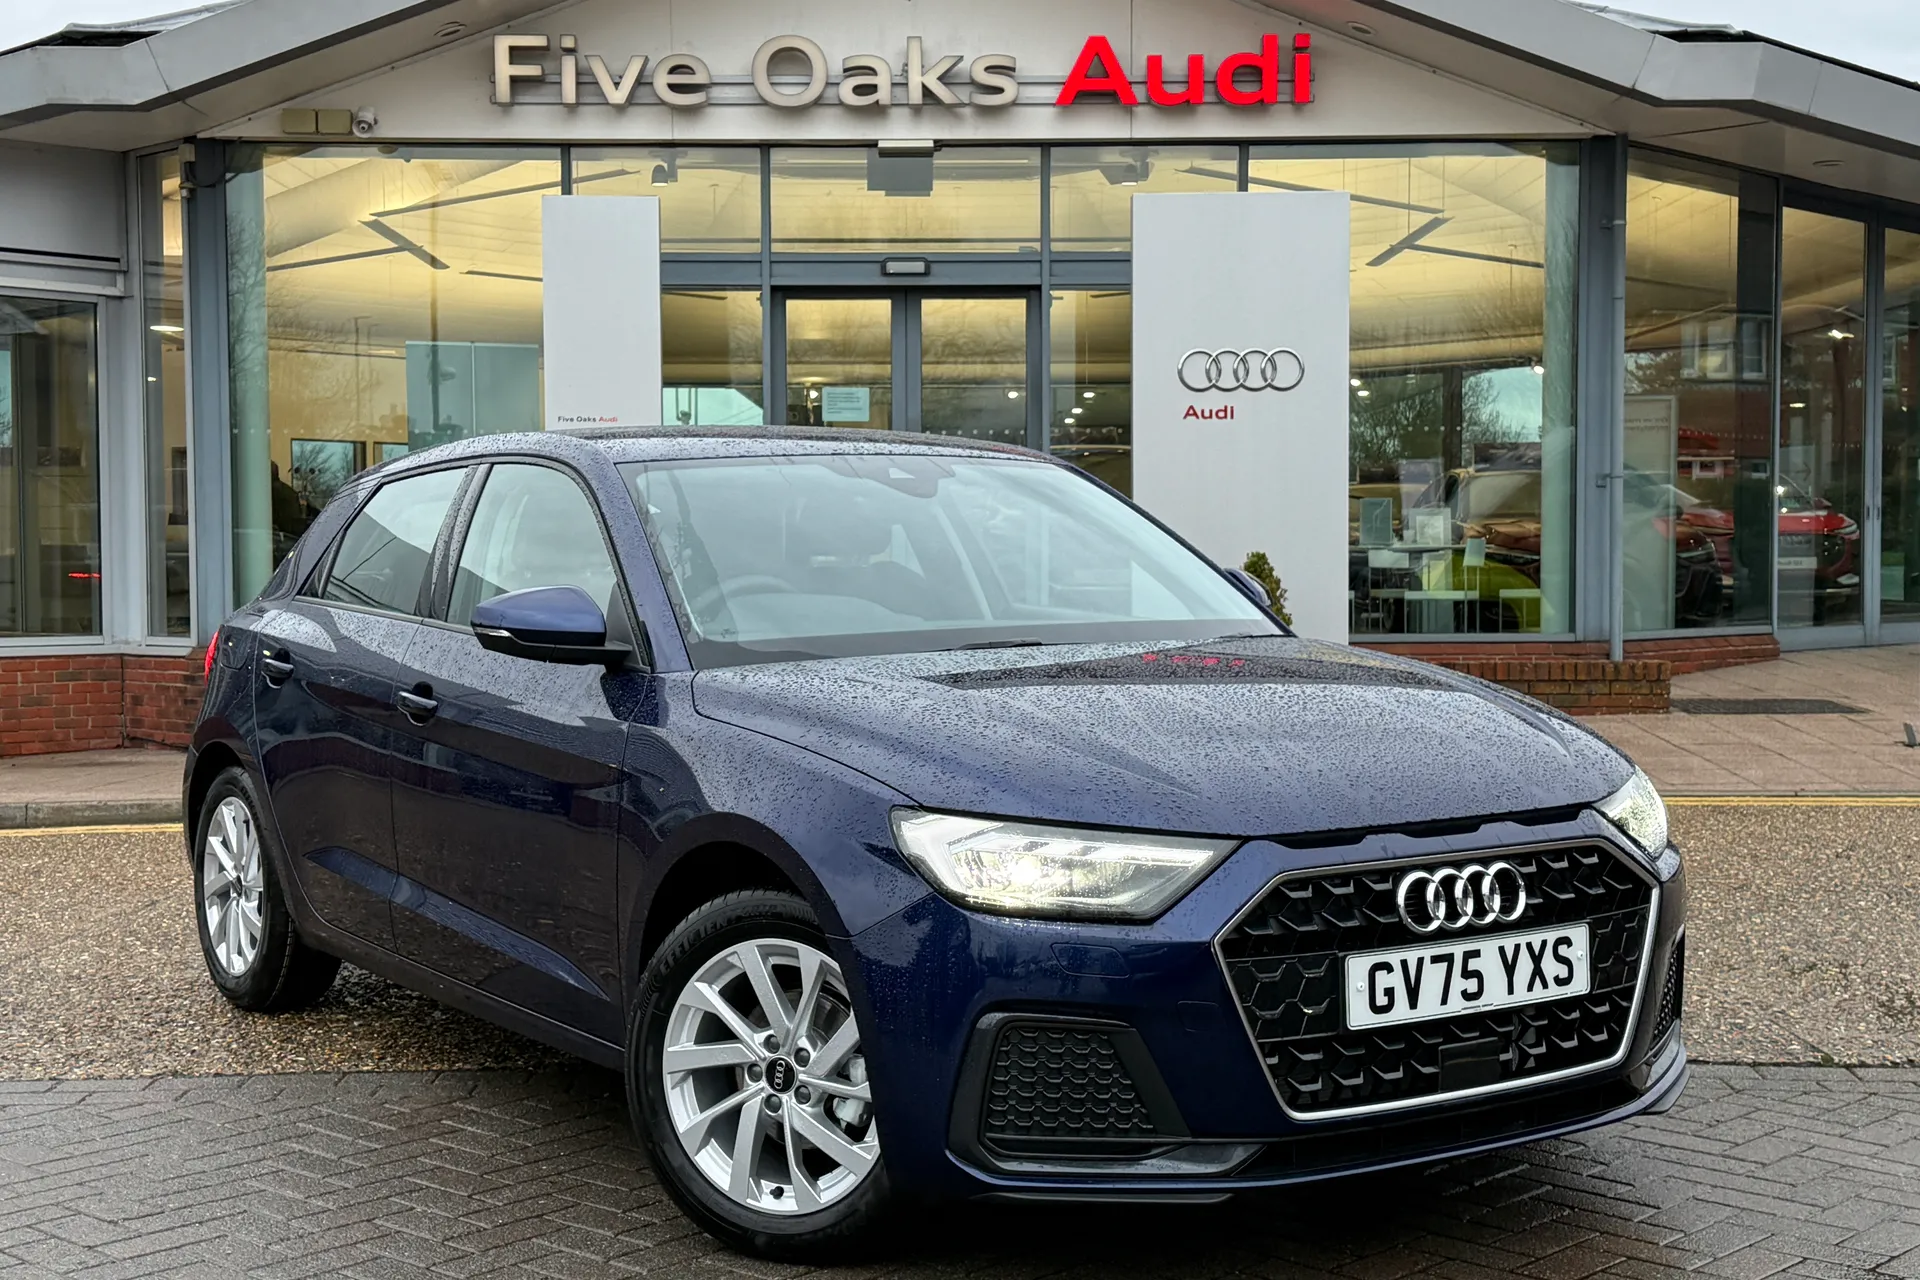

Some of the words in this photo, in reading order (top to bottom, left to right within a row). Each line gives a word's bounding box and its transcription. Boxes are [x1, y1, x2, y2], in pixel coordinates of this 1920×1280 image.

[493, 34, 712, 108] Five
[752, 34, 1019, 108] Oaks
[1055, 33, 1312, 107] Audi
[1183, 405, 1234, 420] Audi
[1368, 948, 1484, 1015] GV75
[1498, 936, 1574, 996] YXS
